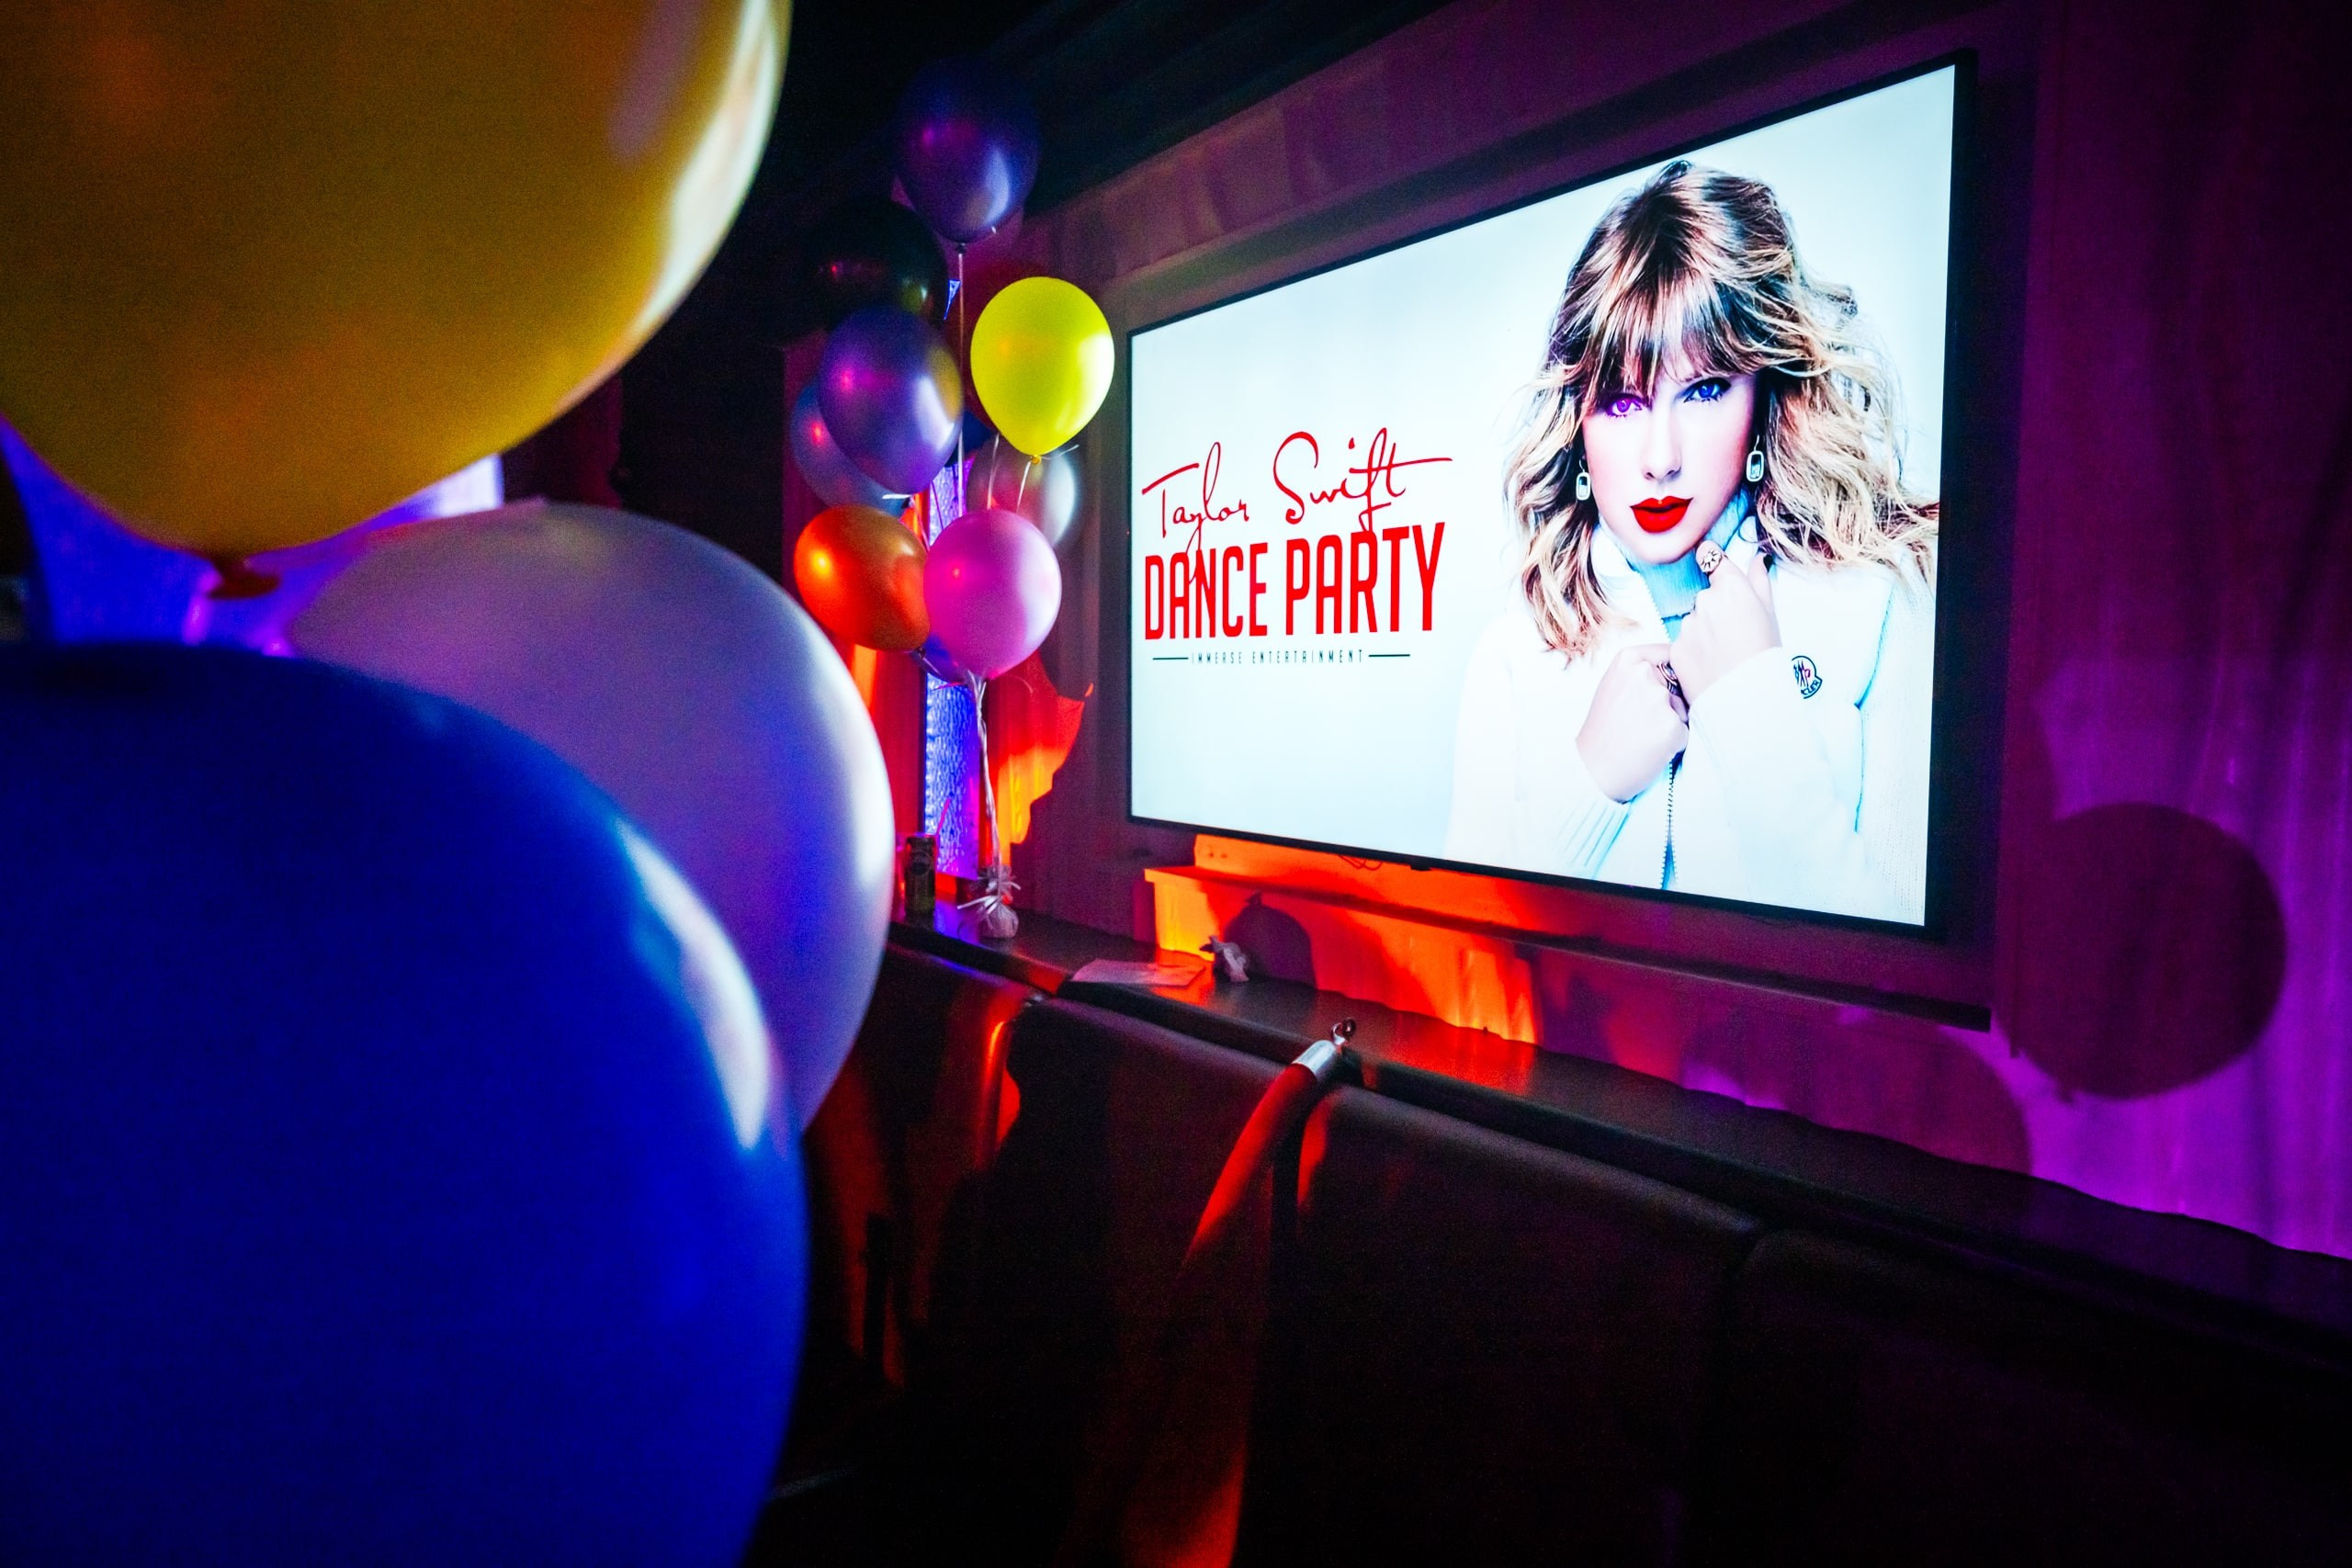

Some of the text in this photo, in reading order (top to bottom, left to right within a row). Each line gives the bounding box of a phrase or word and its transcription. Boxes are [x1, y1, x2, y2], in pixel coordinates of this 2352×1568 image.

[1142, 427, 1453, 582] Taylor Swift
[1145, 522, 1446, 640] DANCE PARTY
[1191, 649, 1365, 665] IMMERSE ENTERTAINMENT
